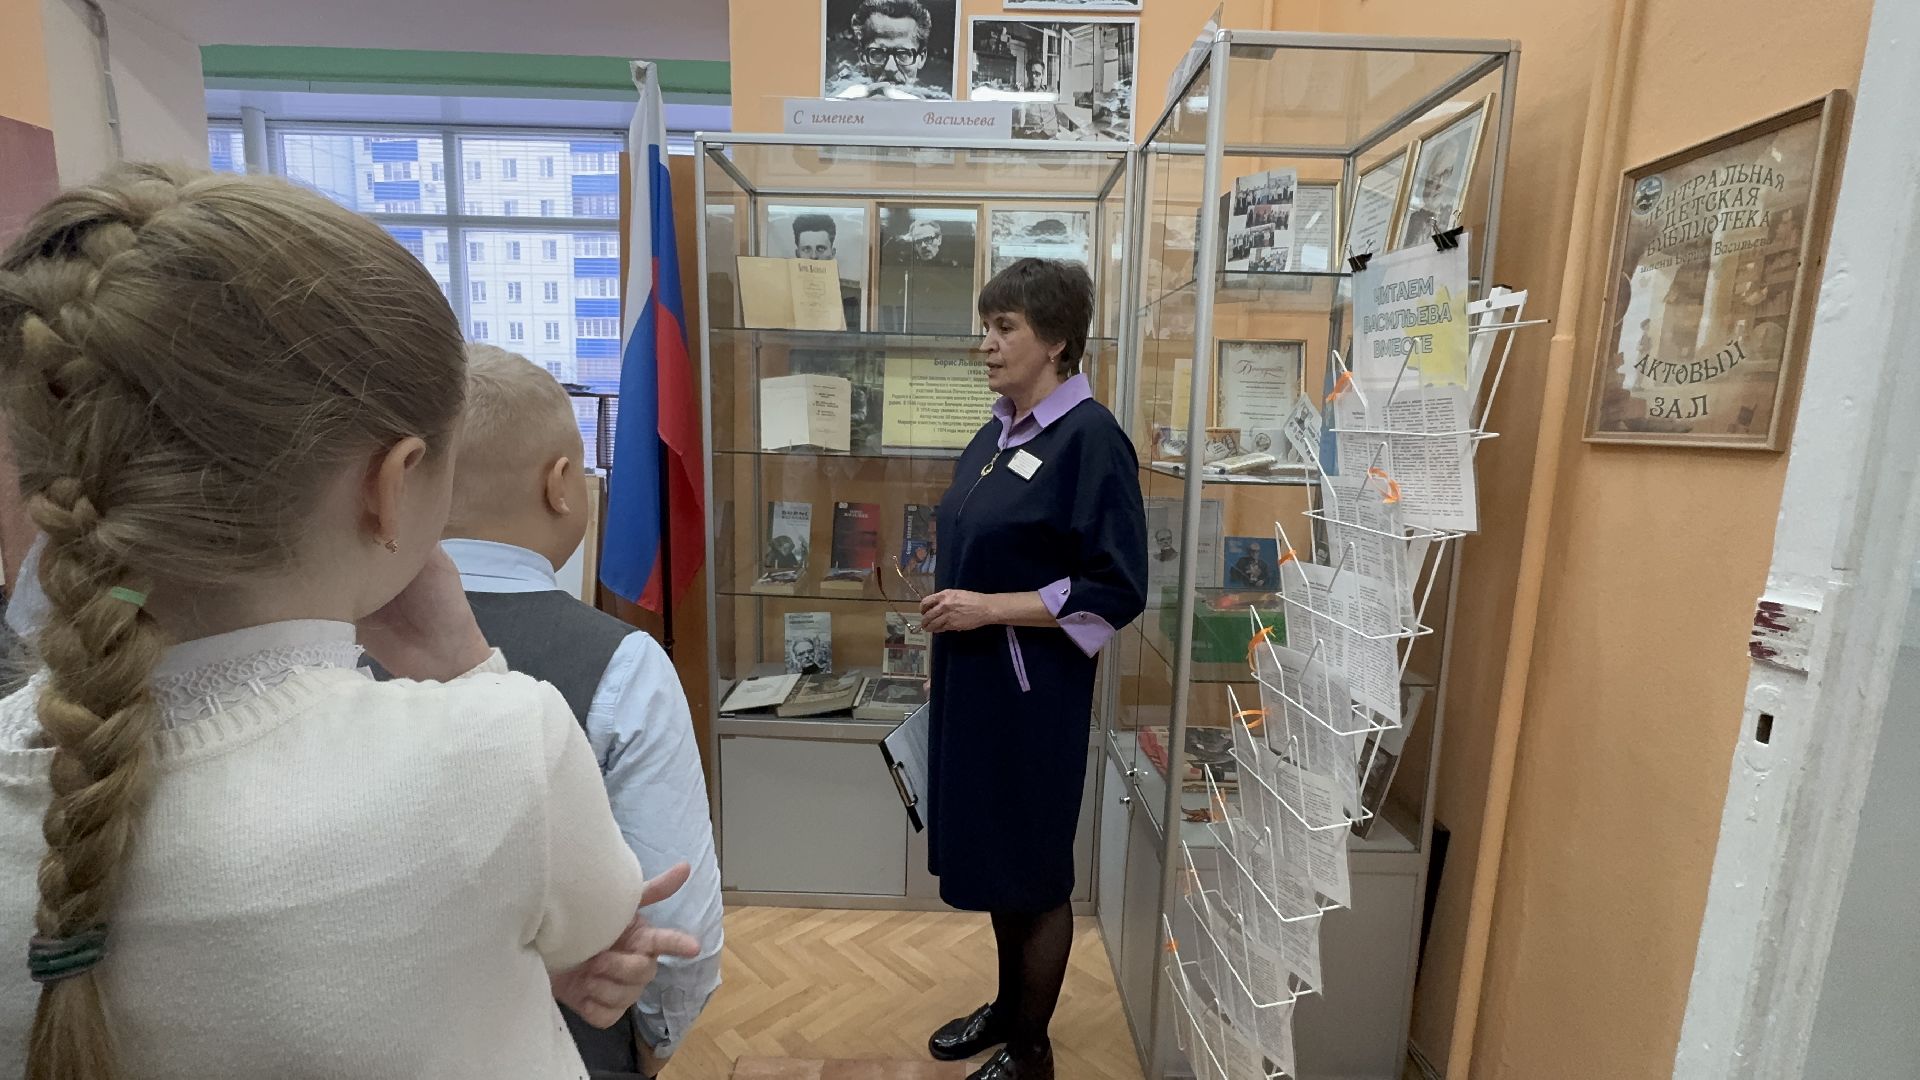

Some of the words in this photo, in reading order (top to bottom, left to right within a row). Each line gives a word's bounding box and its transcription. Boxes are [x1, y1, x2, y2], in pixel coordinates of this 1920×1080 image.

[793, 110, 804, 124] С
[811, 112, 865, 124] именем
[922, 111, 995, 127] Васильева
[1662, 187, 1760, 233] ДЕТСКАЯ
[1647, 209, 1771, 257] БИБЛИОТЕКА
[1373, 275, 1434, 306] ЧИТАЕМ
[1363, 302, 1452, 335] ВАСИЛЬЕВА
[1373, 333, 1433, 359] ВМЕСТЕ
[1633, 339, 1746, 385] АКТОВЫЙ
[1649, 394, 1708, 419] ЗАЛ
